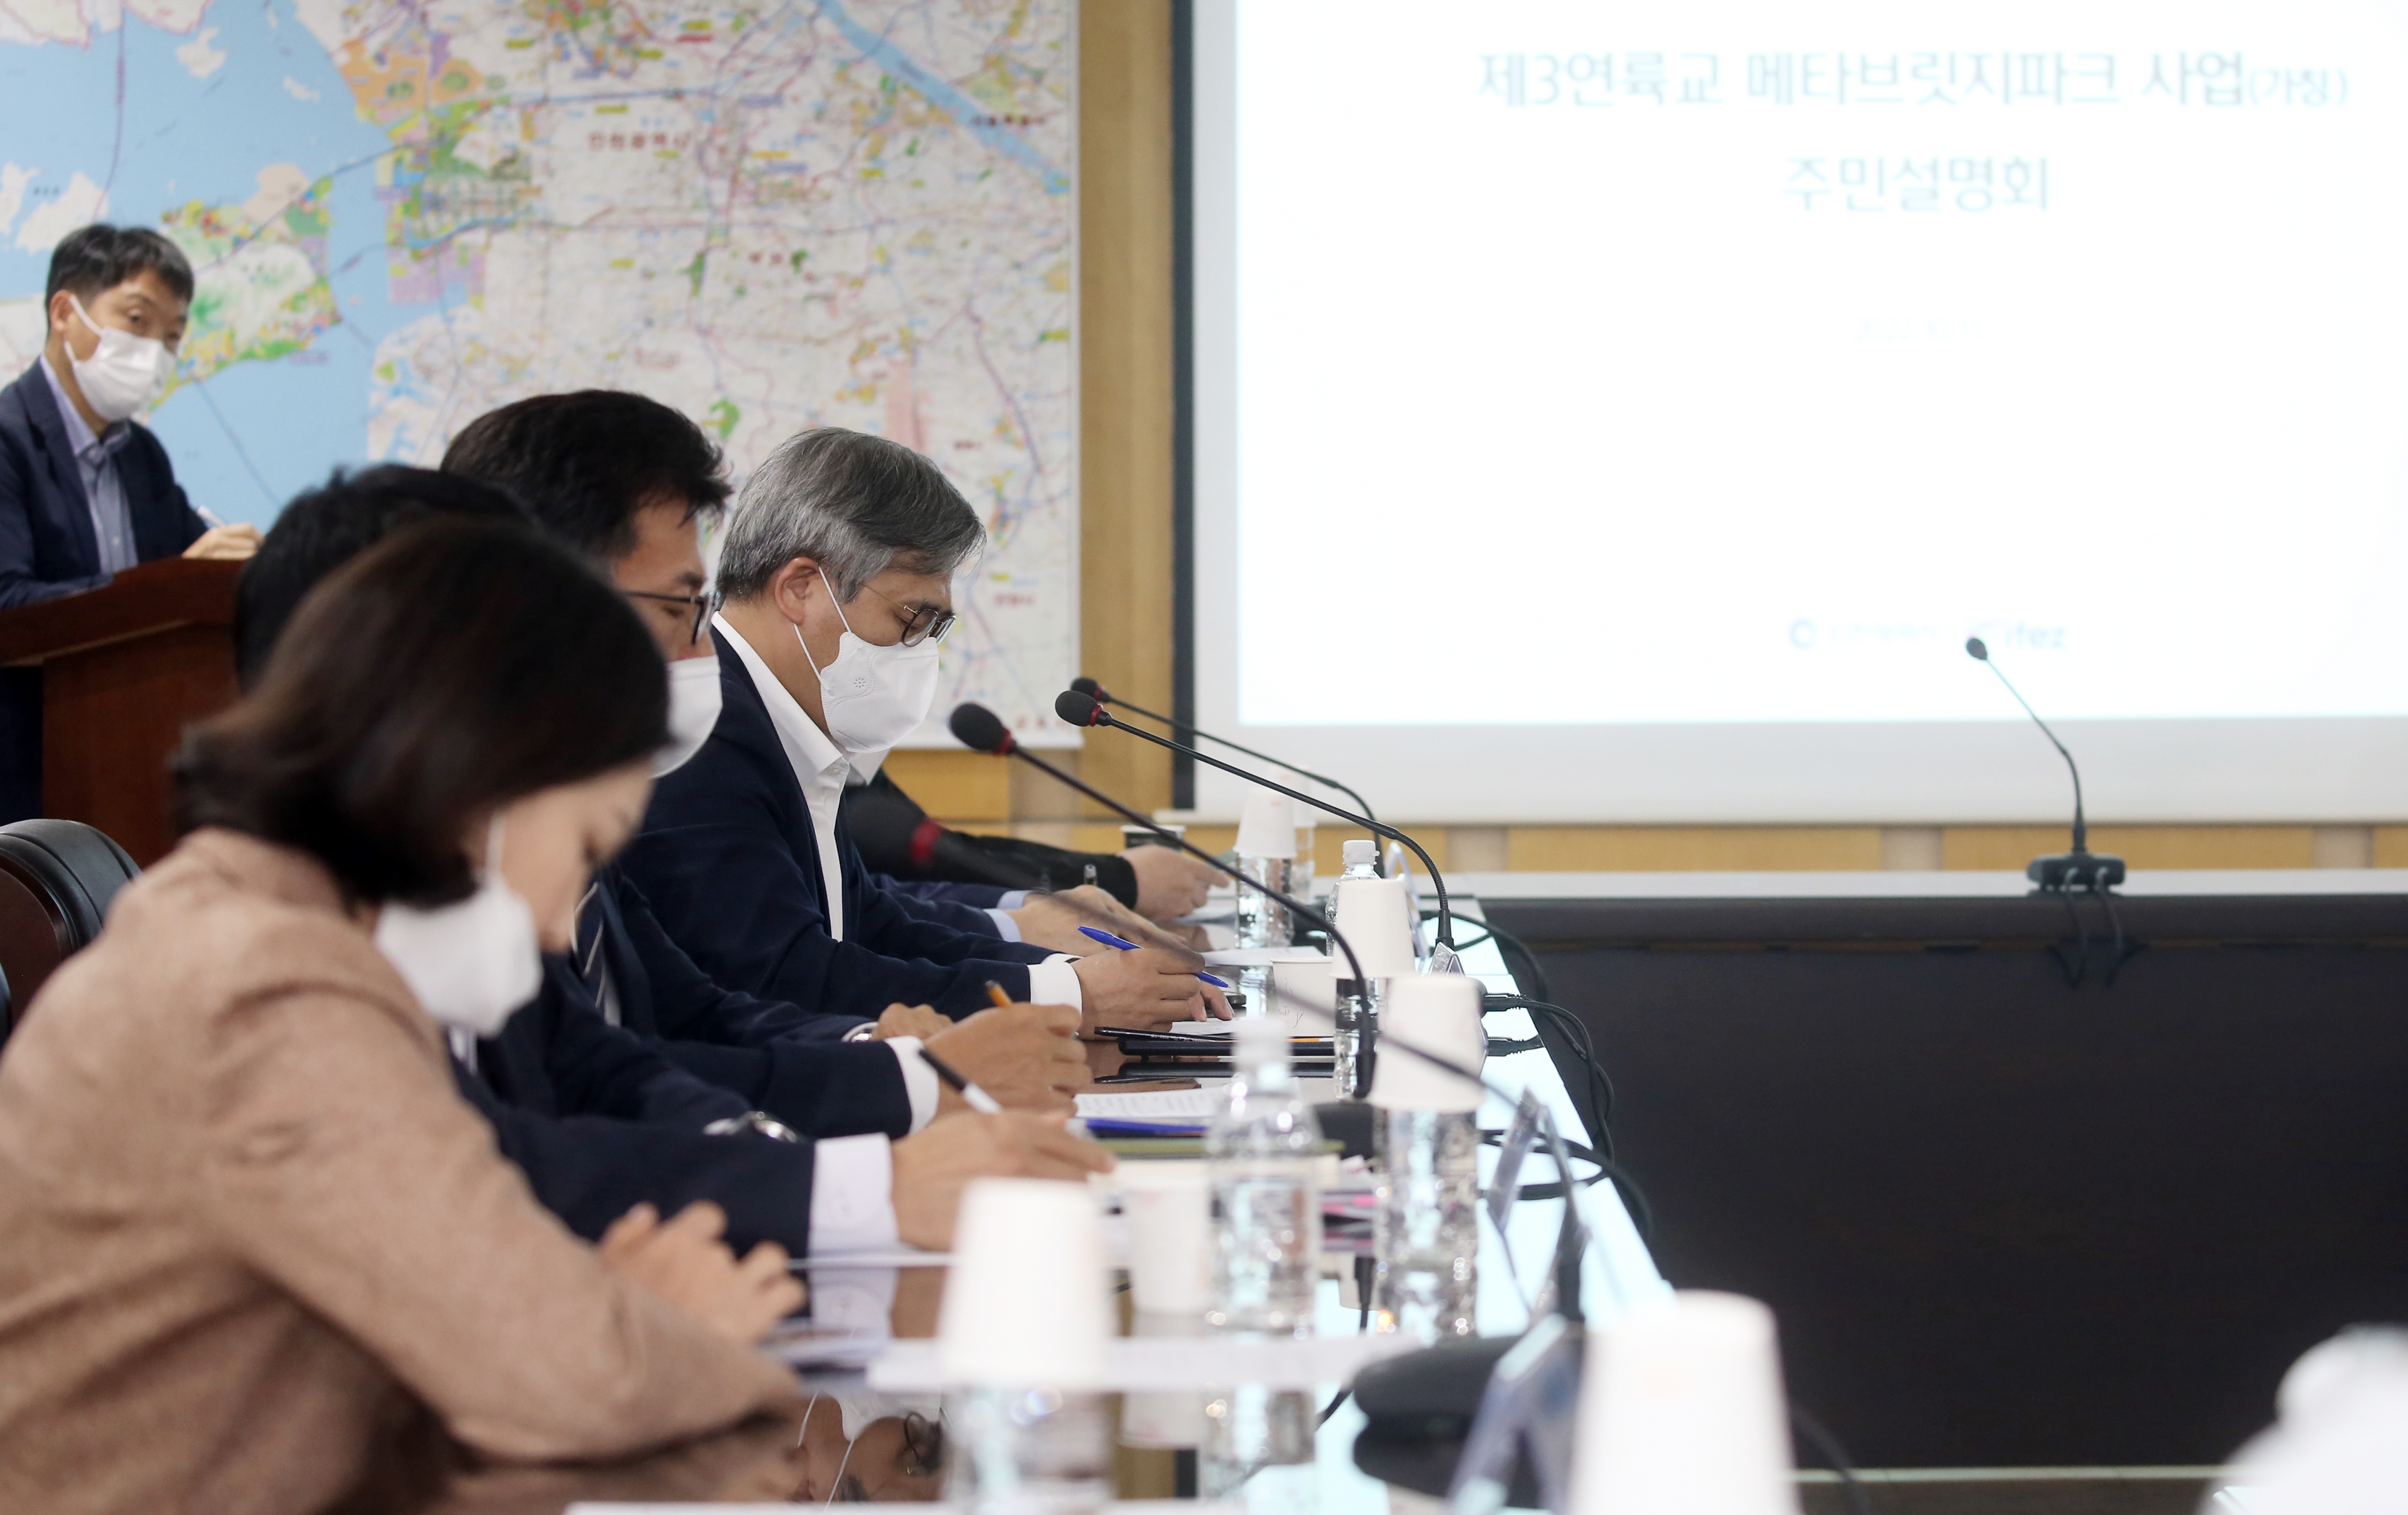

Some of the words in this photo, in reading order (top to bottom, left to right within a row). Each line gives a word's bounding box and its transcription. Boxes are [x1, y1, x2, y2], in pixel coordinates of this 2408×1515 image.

[1478, 51, 1722, 107] 제3연륙교
[1746, 50, 2120, 105] 메타브릿지파크
[2142, 50, 2349, 107] 사업(가칭)
[1783, 155, 2050, 212] 주민설명회
